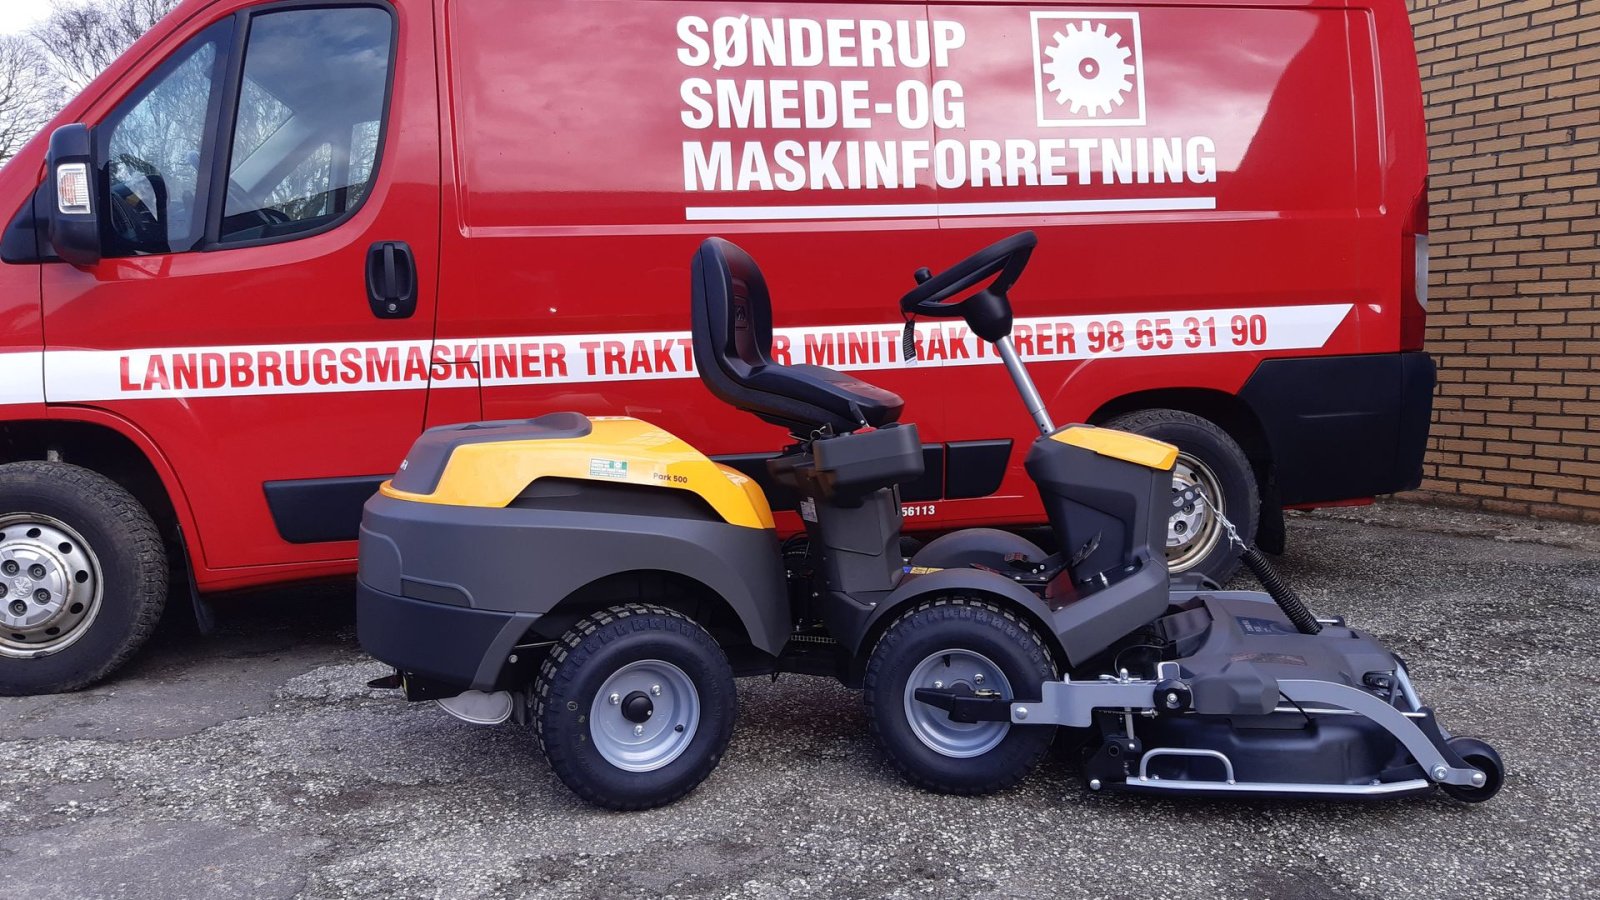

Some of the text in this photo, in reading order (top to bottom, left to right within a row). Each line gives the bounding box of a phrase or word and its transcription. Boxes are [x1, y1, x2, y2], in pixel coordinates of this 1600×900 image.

[676, 14, 966, 70] SØNDERUP
[680, 78, 966, 130] SMEDE-OG
[682, 136, 1217, 192] MASKINFORRETNING
[120, 343, 567, 391] LANDBRUGSMASKINER
[579, 333, 793, 376] TRAKTR
[805, 322, 1076, 364] MINITRAKTRER
[1087, 317, 1124, 354] 98
[1136, 315, 1172, 350] 65
[1184, 315, 1218, 348] 31
[1231, 313, 1267, 347] 90
[653, 472, 688, 483] Park 500
[901, 505, 935, 517] 56113
